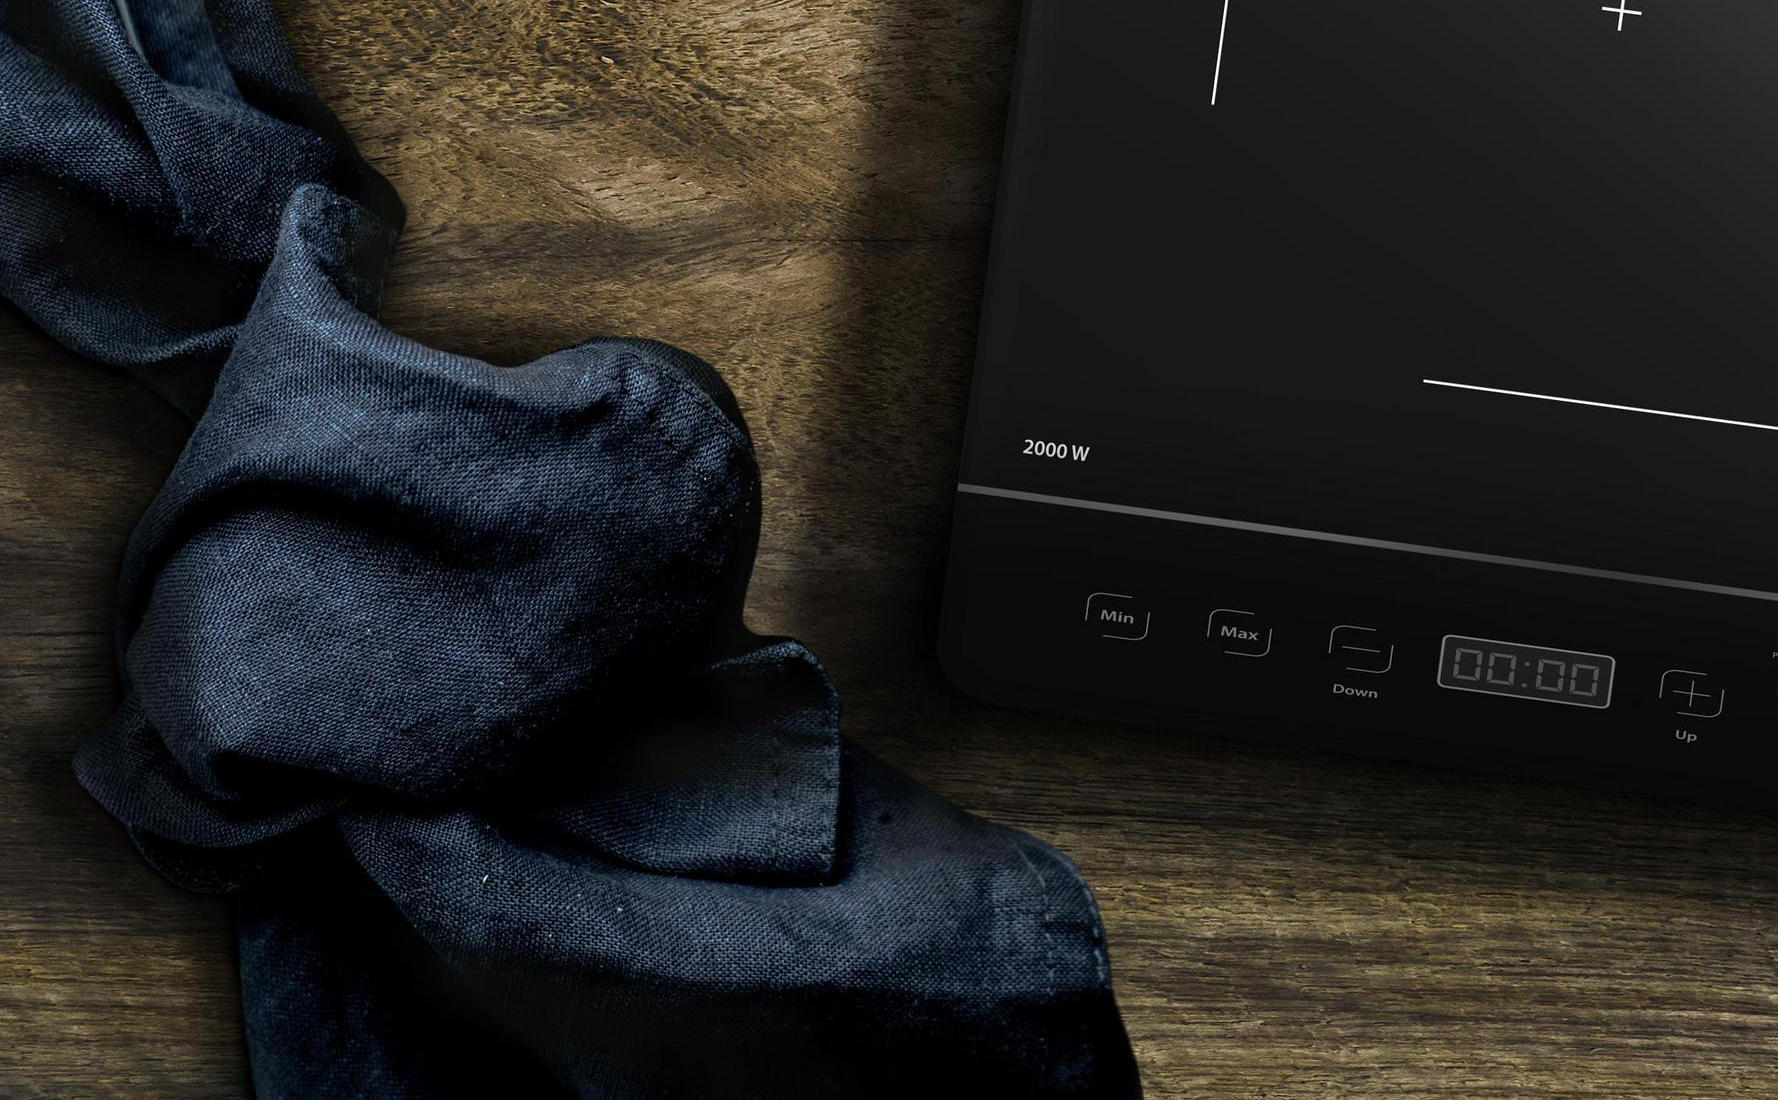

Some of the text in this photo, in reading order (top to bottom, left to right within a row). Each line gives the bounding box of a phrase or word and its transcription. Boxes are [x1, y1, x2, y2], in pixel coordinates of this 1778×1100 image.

[1022, 439, 1090, 462] 2000 W
[1100, 608, 1135, 625] Min
[1220, 624, 1259, 641] Max
[1332, 683, 1378, 699] Down
[1675, 729, 1698, 743] Up
